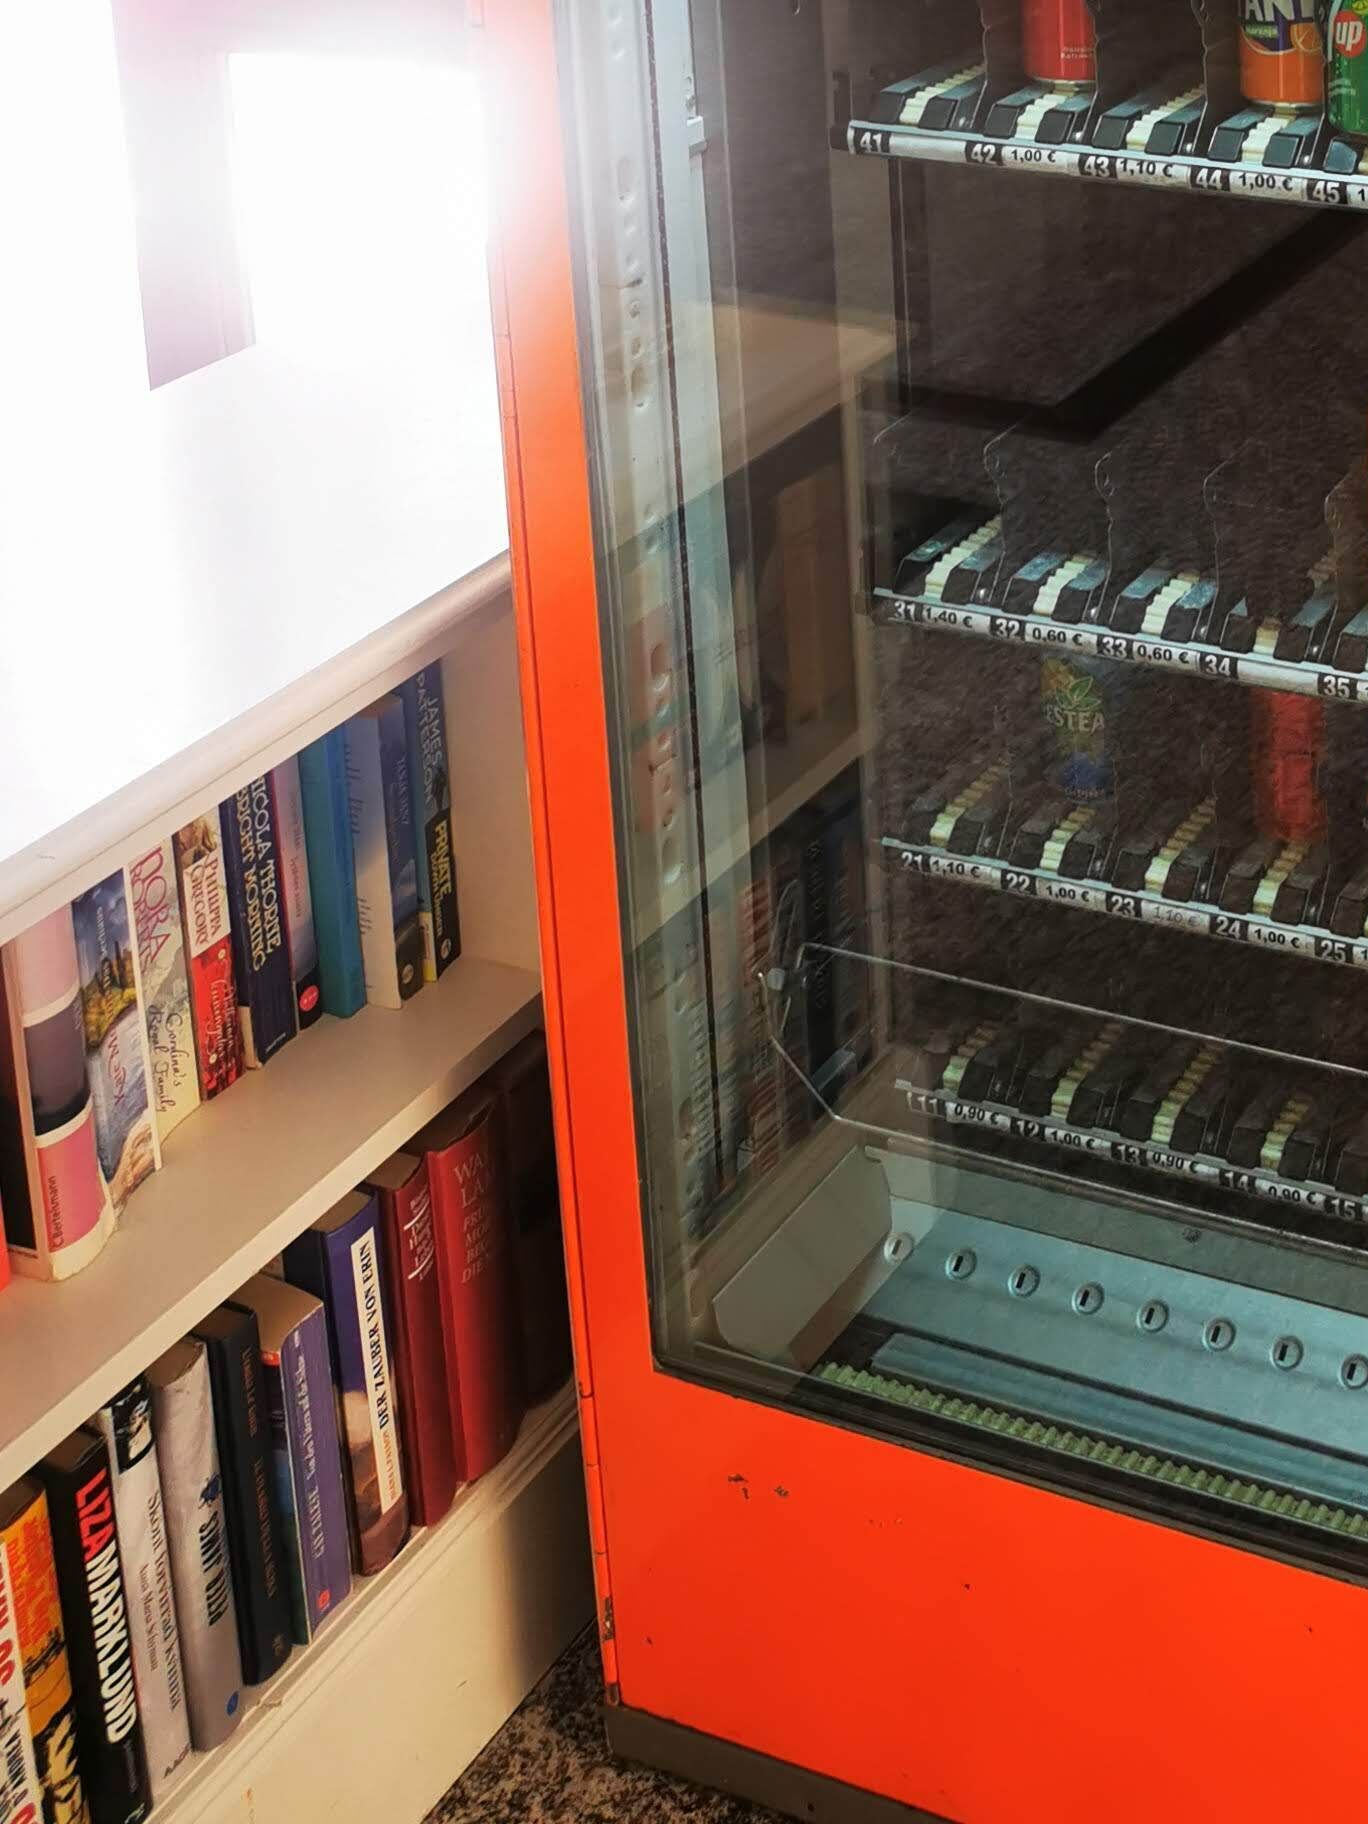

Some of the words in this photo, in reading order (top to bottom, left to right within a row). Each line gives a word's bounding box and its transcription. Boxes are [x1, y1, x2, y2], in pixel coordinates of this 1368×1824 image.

[860, 131, 883, 154] 41
[971, 142, 997, 165] 42
[1010, 147, 1044, 164] 1,00
[1046, 150, 1057, 164] €
[1085, 155, 1110, 178] 43
[1119, 159, 1158, 177] 1,10
[1162, 162, 1174, 178] €
[1196, 167, 1222, 192] 44
[1238, 172, 1277, 191] 1,00
[1280, 175, 1294, 191] €
[1313, 178, 1341, 205] 45
[893, 600, 917, 622] 31
[925, 606, 958, 627] 1,40
[962, 613, 974, 629] €
[995, 617, 1021, 639] 32
[1031, 626, 1067, 646] 0,60
[1071, 631, 1083, 647] €
[1100, 635, 1127, 658] 33
[1136, 643, 1172, 663] 0,60
[1176, 649, 1190, 665] €
[1204, 654, 1231, 677] 34
[1323, 674, 1350, 698] 35
[425, 695, 442, 766] JAMES
[433, 820, 452, 896] PRIVATE
[900, 851, 924, 872] 21
[931, 857, 967, 878] 1,10
[206, 857, 223, 937] PHILIPPA
[1006, 872, 1031, 893] 22
[1045, 884, 1079, 901] 1,00
[1080, 888, 1091, 902] €
[190, 862, 208, 947] GREGORY
[244, 865, 266, 971] MORNING
[261, 860, 282, 954] THORNE
[1110, 893, 1135, 915] 23
[1151, 903, 1183, 923] 1,10
[1216, 915, 1242, 939] 24
[1254, 927, 1288, 947] 1,00
[1290, 933, 1301, 949] €
[1320, 939, 1348, 963] 25
[953, 1104, 987, 1122] 0,90
[1049, 1130, 1082, 1148] 1,00
[1152, 1151, 1185, 1170] 0,90
[1226, 1170, 1249, 1189] 14
[1331, 1199, 1356, 1220] 15
[358, 1241, 374, 1288] ERIN
[362, 1288, 379, 1324] VON
[368, 1326, 385, 1391] ZAUBER
[374, 1393, 389, 1430] DER
[75, 1468, 118, 1563] LIZA
[85, 1540, 138, 1745] MARKLUND
